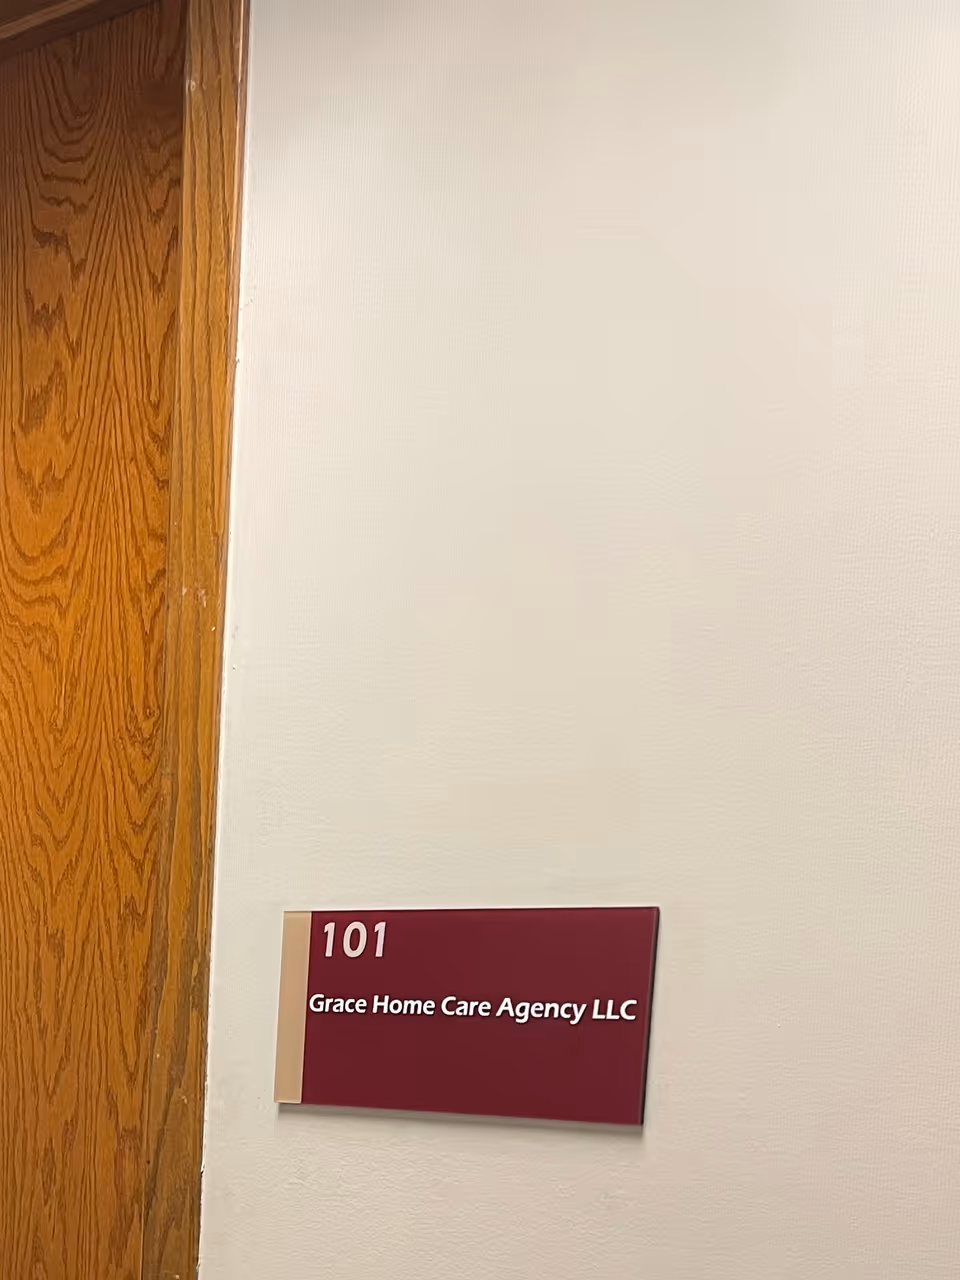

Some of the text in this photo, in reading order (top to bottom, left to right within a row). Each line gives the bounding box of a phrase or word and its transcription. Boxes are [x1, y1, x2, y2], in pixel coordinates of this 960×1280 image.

[323, 921, 387, 958] 101
[308, 993, 638, 1025] Grace Home Care Agency LLC
